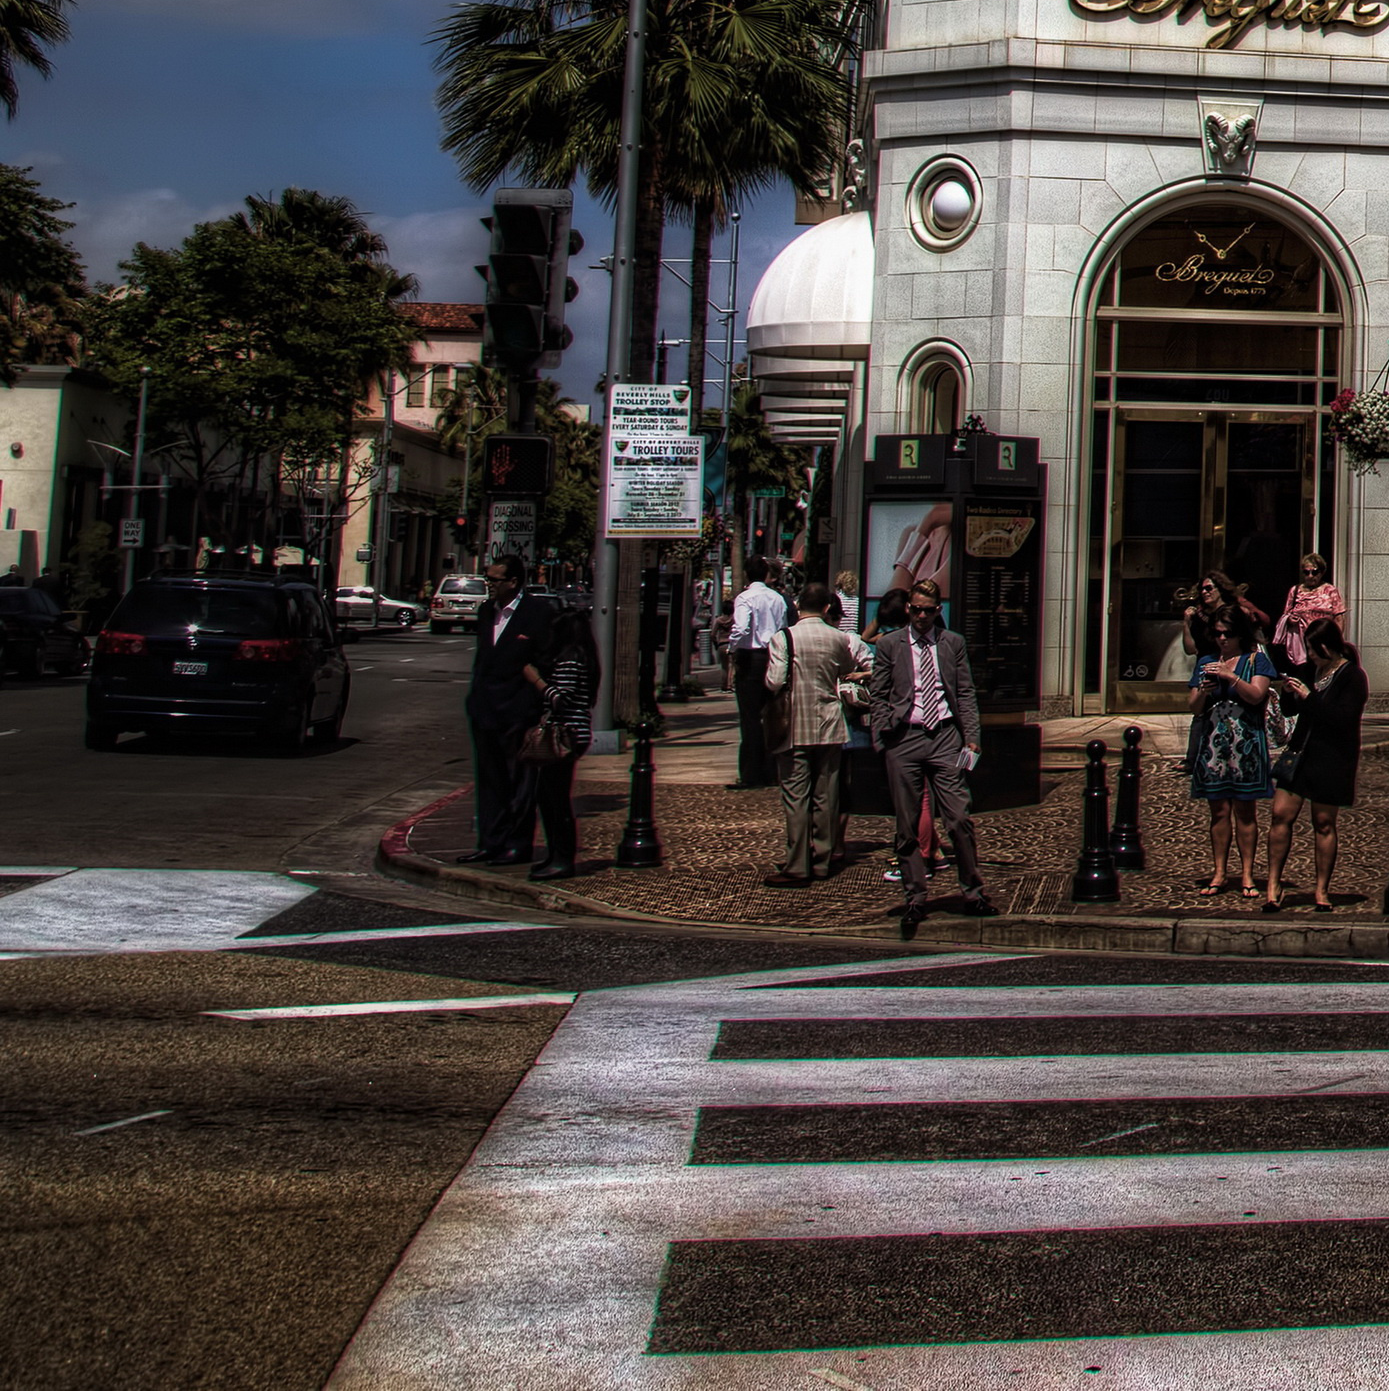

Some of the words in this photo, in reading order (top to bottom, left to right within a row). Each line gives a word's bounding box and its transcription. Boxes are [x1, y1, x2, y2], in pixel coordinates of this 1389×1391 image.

[1155, 254, 1275, 294] Breguet
[633, 446, 669, 455] TROLLEY
[671, 446, 699, 455] TOURS
[494, 506, 532, 517] DIAGONAL
[493, 521, 534, 532] CROSSING
